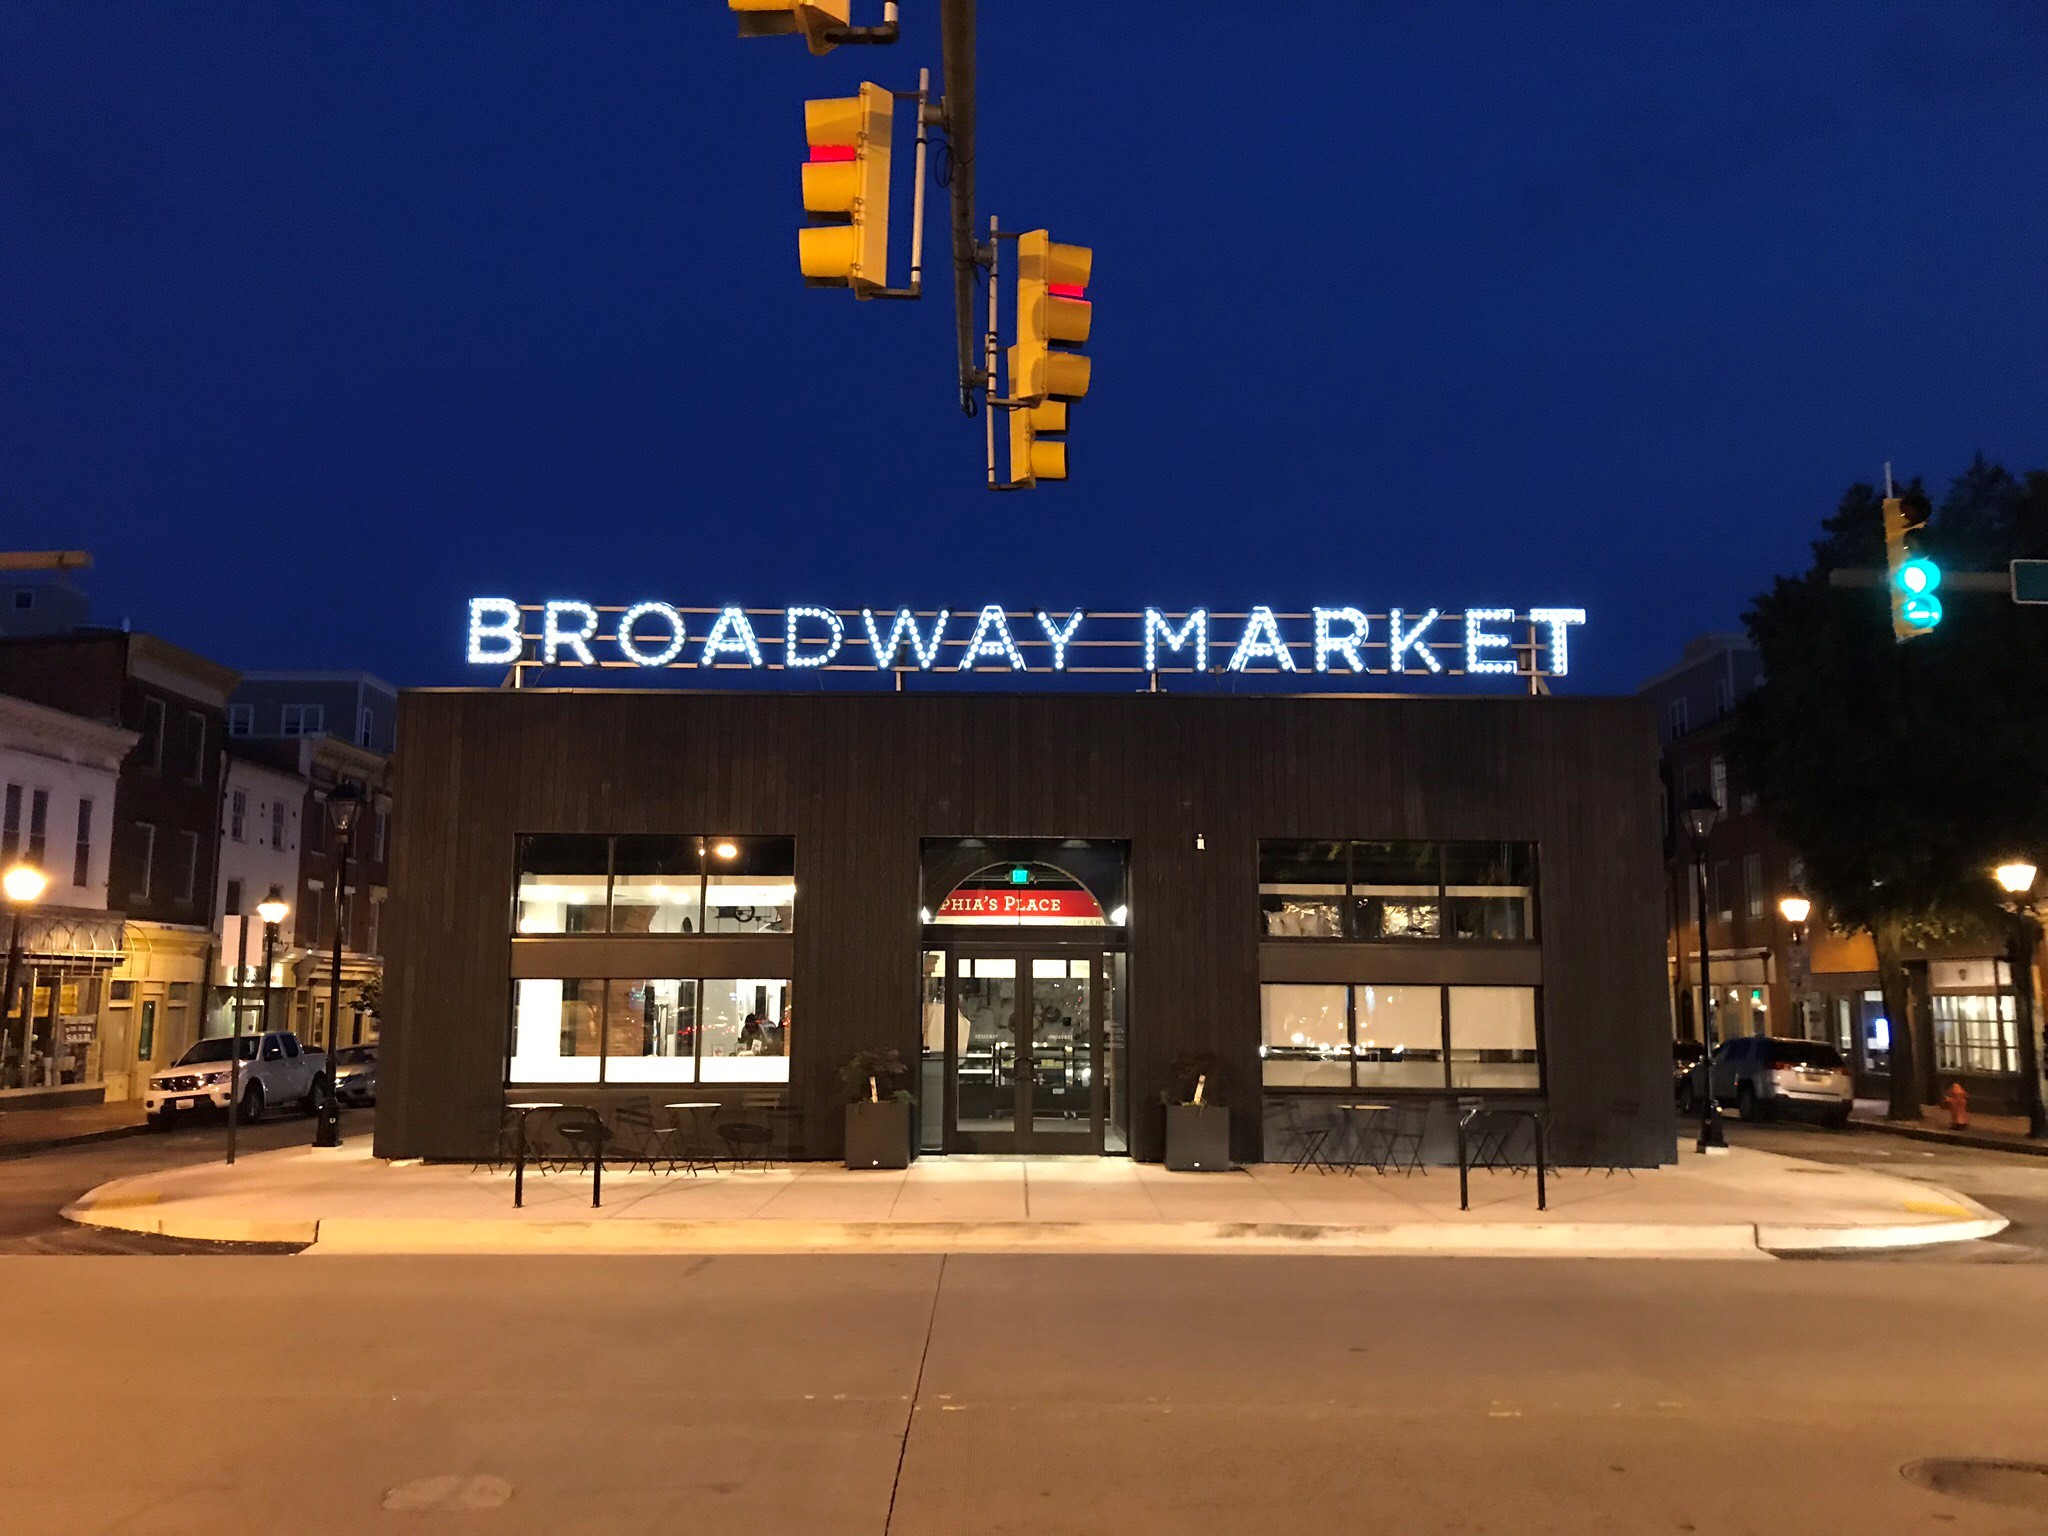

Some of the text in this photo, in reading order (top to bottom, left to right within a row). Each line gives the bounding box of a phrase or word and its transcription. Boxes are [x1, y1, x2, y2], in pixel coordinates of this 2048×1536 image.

[467, 597, 1587, 675] BROADWAY MARKET
[1004, 896, 1061, 911] PLACE
